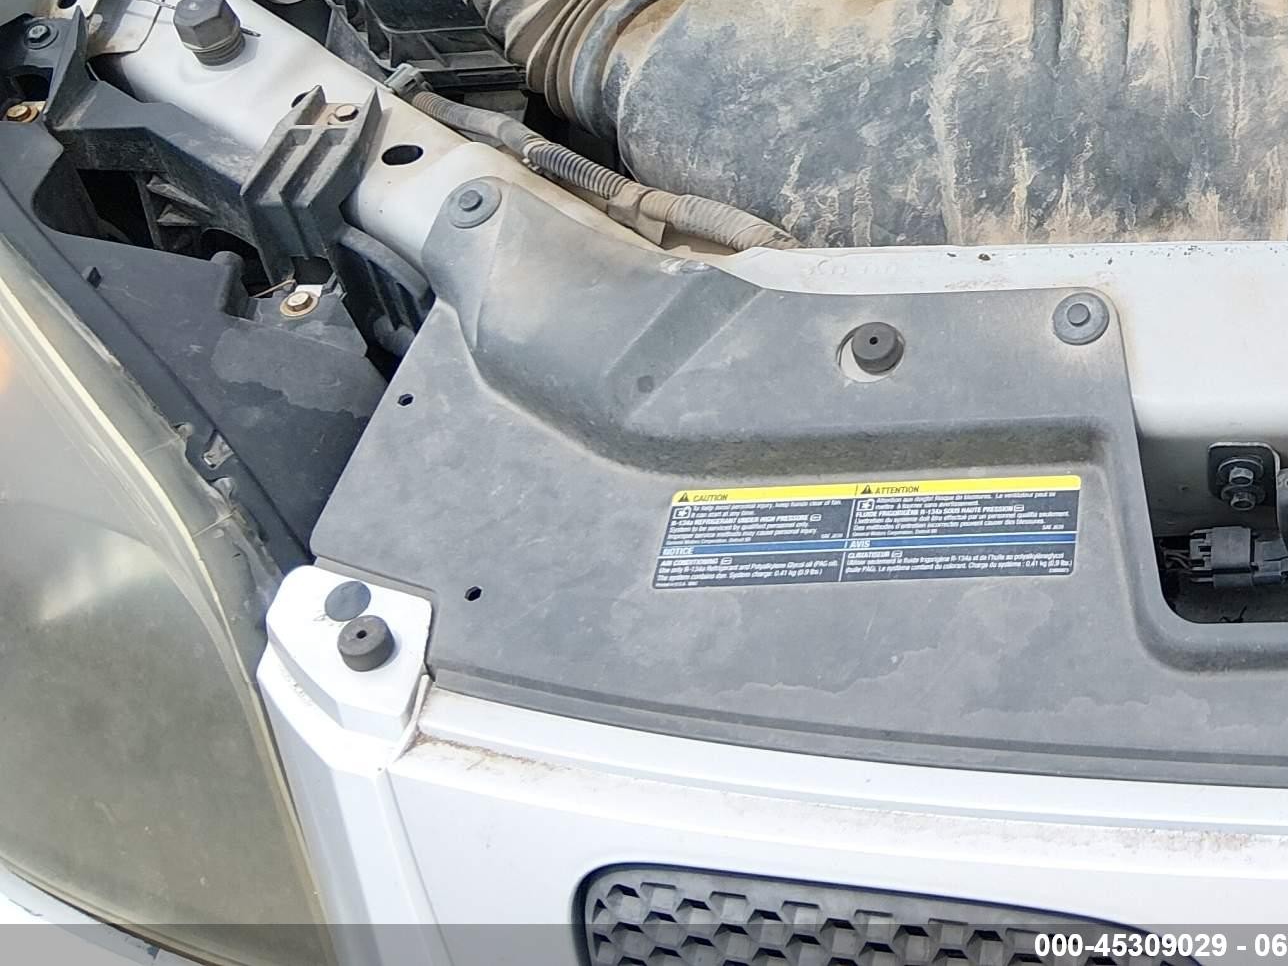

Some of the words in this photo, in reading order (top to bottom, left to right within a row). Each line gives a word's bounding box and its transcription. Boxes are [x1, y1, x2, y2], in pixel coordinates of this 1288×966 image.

[875, 486, 920, 494] ATTENTION
[849, 540, 871, 548] AVIS
[663, 547, 695, 555] NOTICE
